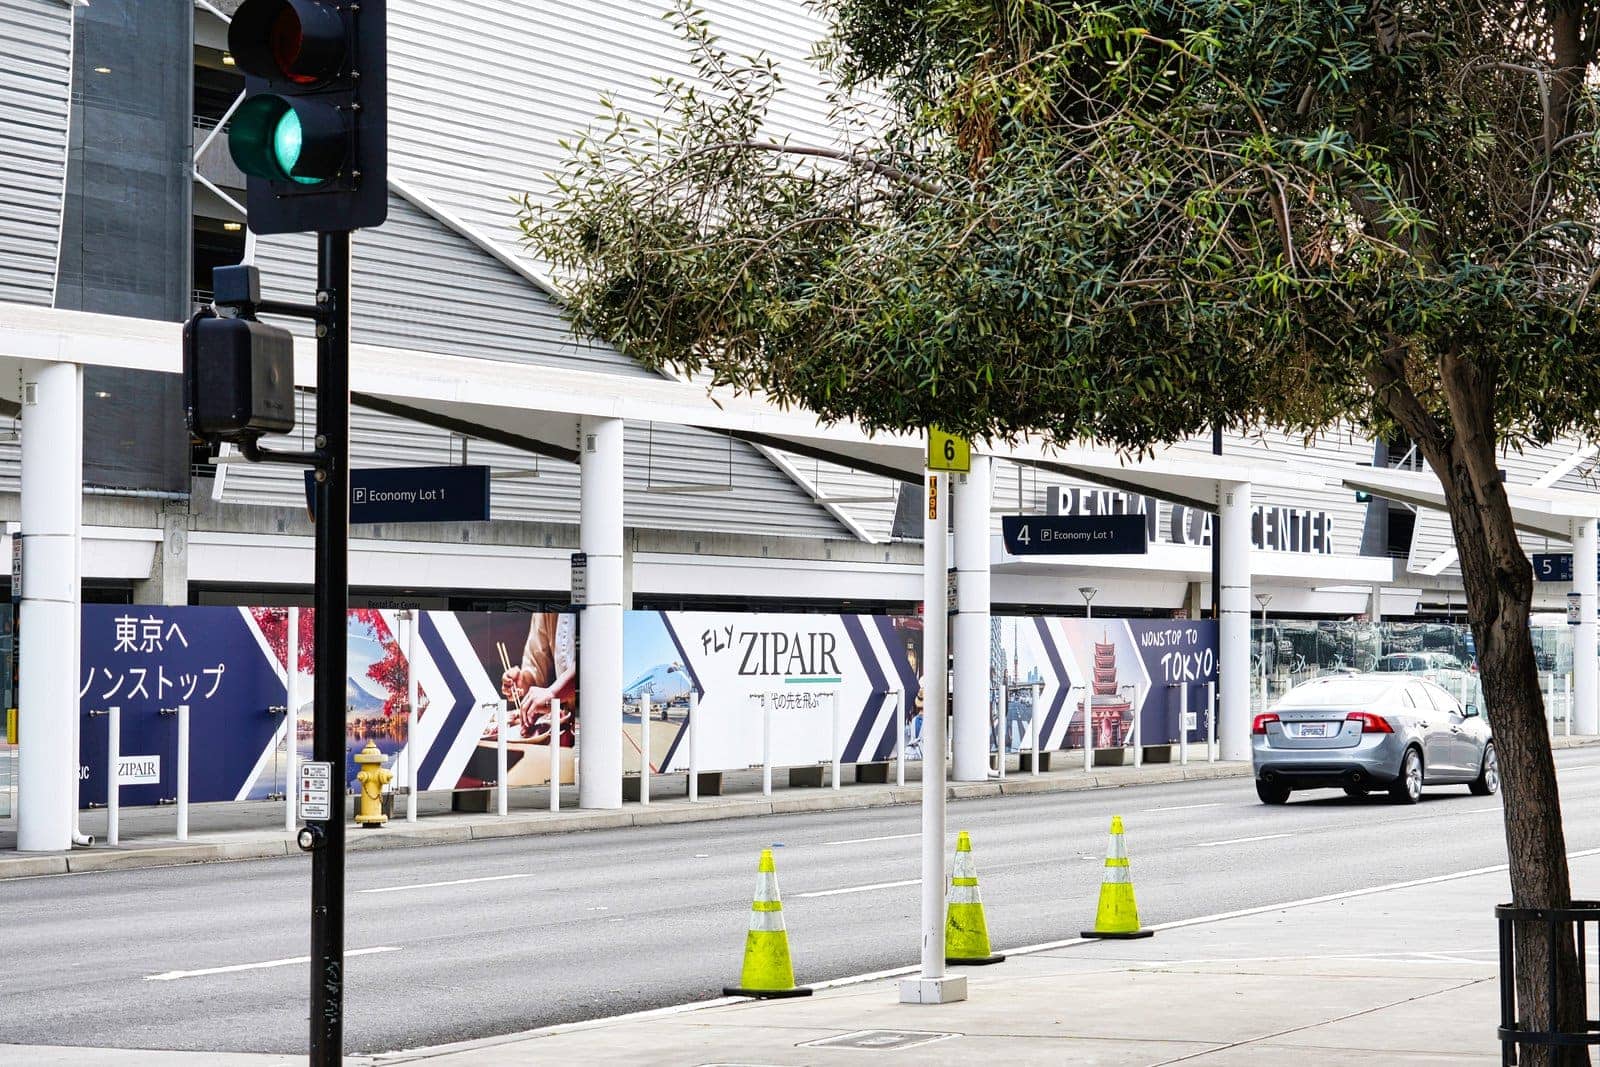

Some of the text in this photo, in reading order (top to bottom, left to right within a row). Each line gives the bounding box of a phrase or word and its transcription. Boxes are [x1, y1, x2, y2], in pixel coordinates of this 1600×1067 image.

[944, 439, 955, 461] 6
[369, 489, 417, 504] Economy
[419, 488, 436, 500] Lot
[440, 488, 445, 500] 1
[1017, 524, 1031, 545] 4
[1054, 530, 1091, 541] Economy
[1093, 530, 1107, 540] Lot
[1109, 530, 1114, 539] 1
[1249, 504, 1335, 556] CENTER
[1542, 559, 1553, 575] 5
[113, 614, 189, 653] 東京へ
[1141, 628, 1198, 647] NONSTOP TO
[701, 624, 842, 676] FLY ZIPAIR
[1161, 647, 1213, 682] TOKYO
[79, 663, 225, 701] ノンストップ
[118, 761, 156, 777] ZIPAIR
